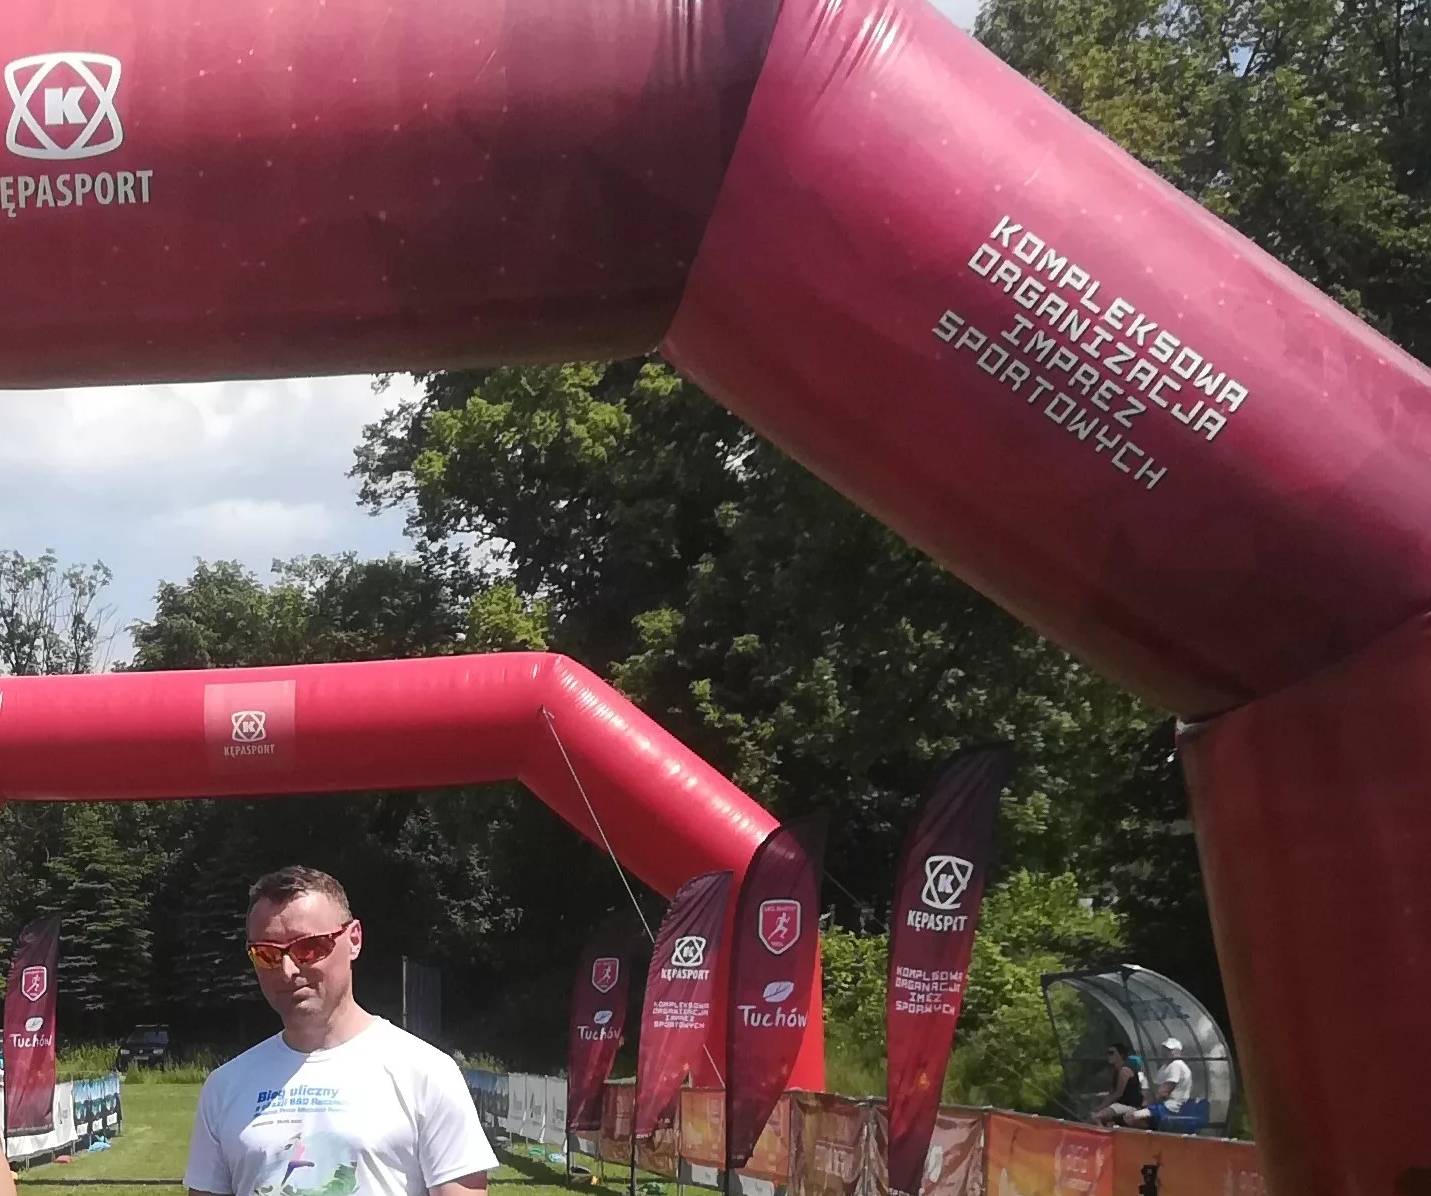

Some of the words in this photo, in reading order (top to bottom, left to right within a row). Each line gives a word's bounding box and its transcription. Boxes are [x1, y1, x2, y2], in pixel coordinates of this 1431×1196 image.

[967, 242, 1227, 440] ORGANIZACJA
[989, 214, 1249, 412] KOMPLEKSOWA
[1000, 313, 1147, 428] IMPREZ
[931, 310, 1168, 490] SPORTOWYCH
[223, 744, 276, 758] KĘPASPORT
[737, 1005, 808, 1028] Tuchów
[289, 1084, 340, 1099] uliczny
